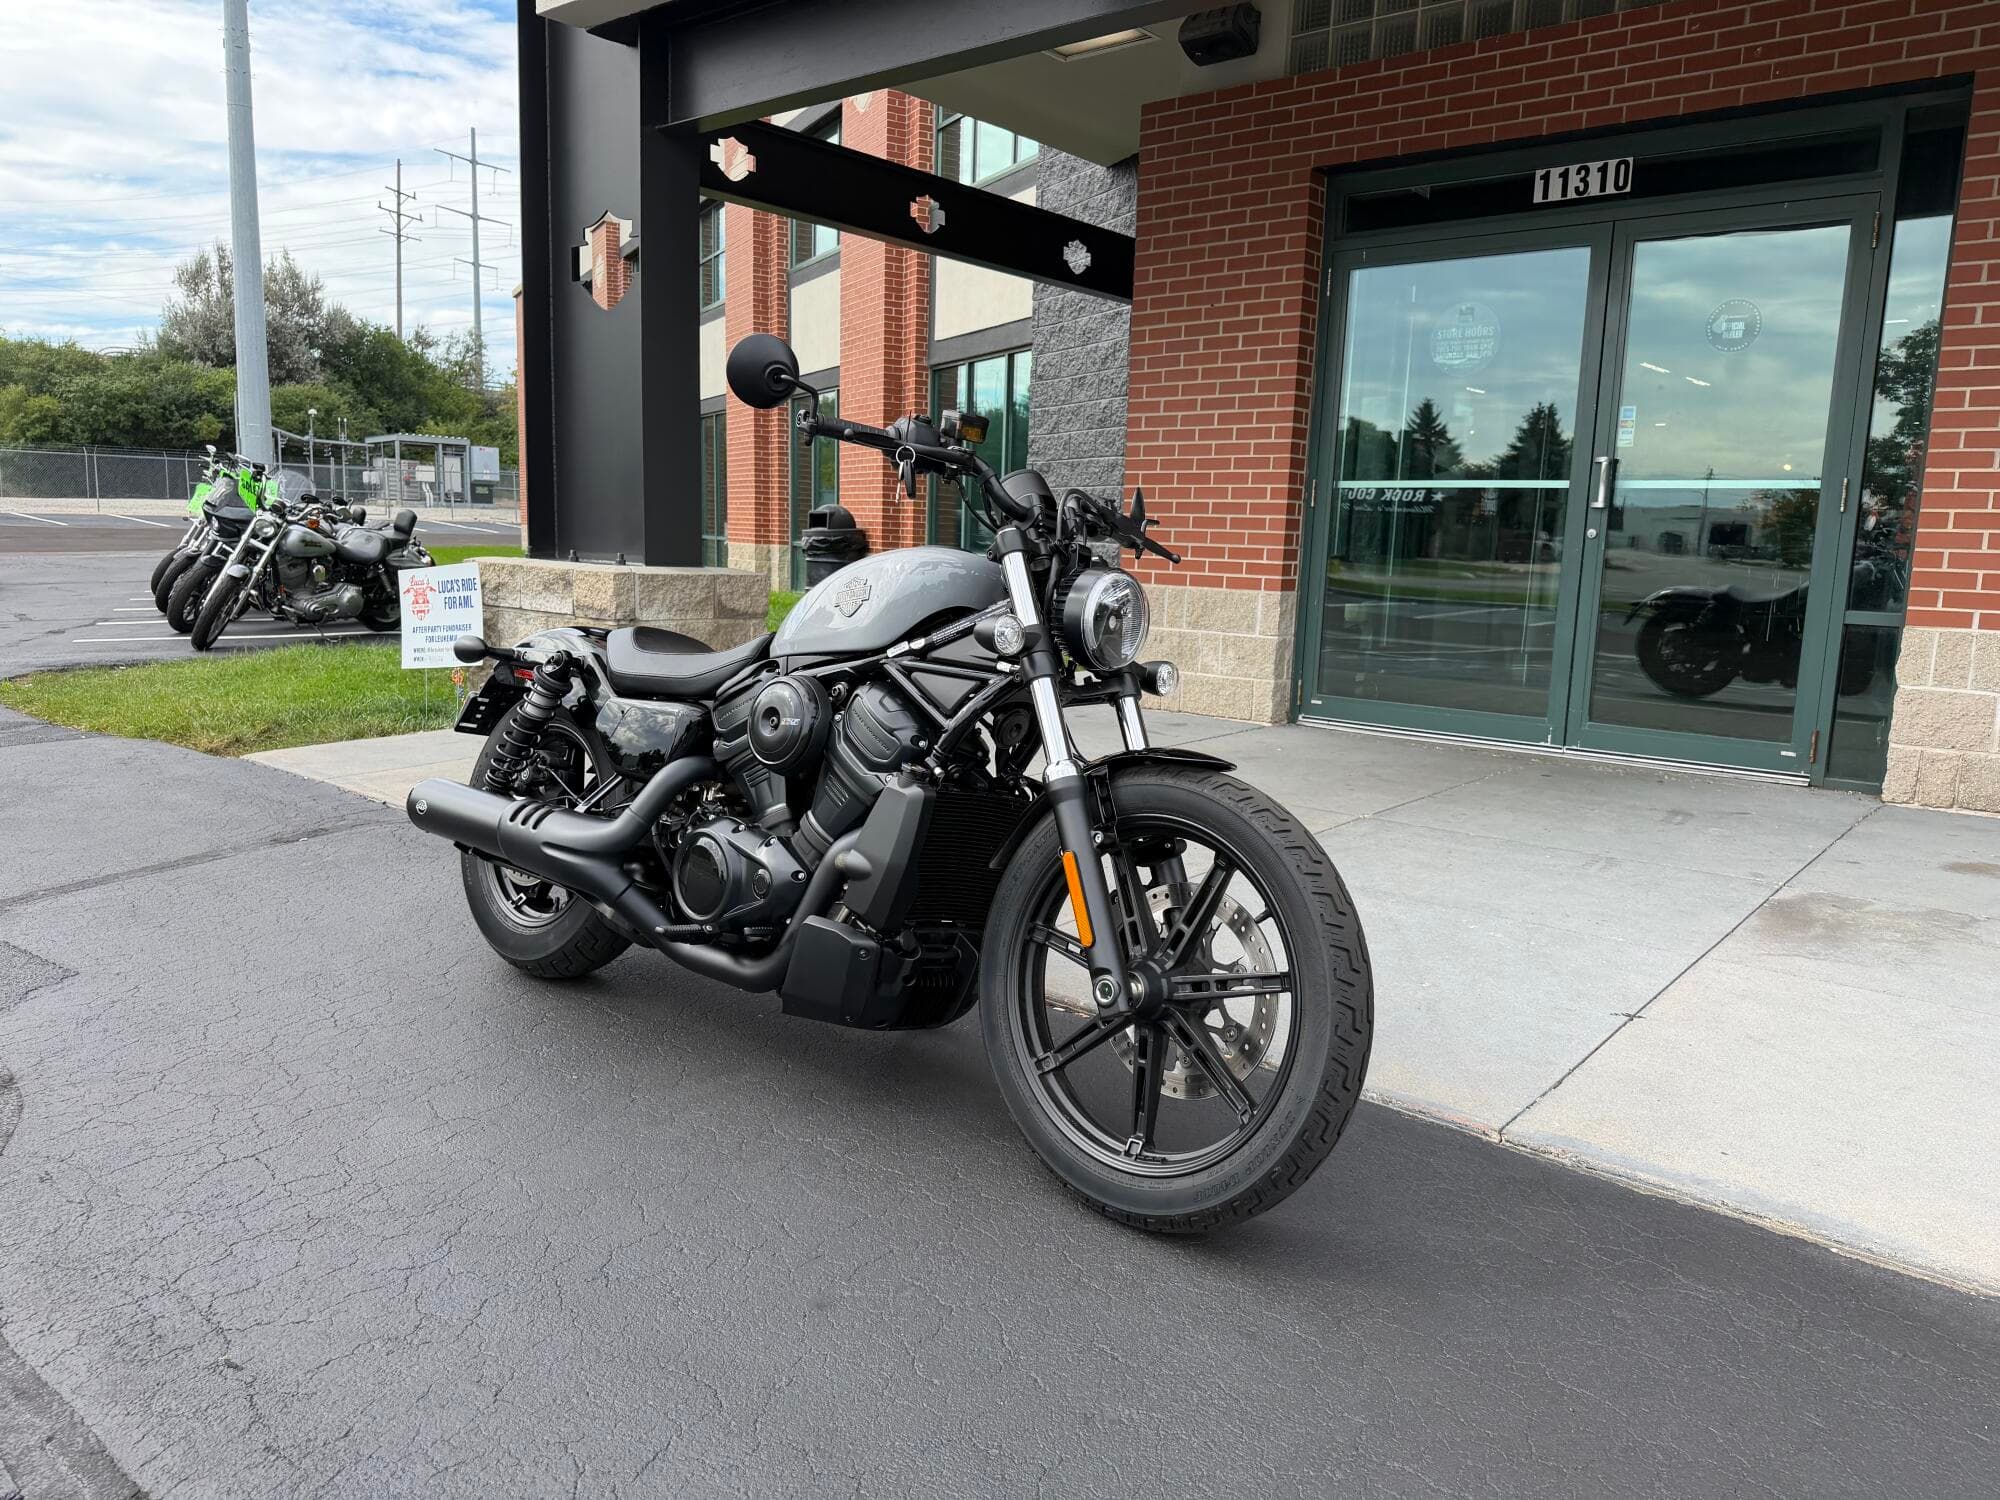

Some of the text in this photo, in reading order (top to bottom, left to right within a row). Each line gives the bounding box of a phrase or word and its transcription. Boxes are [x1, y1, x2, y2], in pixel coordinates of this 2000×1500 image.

[1539, 159, 1631, 201] 11310
[437, 577, 478, 594] LUCA'S RIDE
[443, 596, 458, 610] FOR
[458, 595, 474, 609] AML
[442, 624, 472, 632] FUNDRAISER
